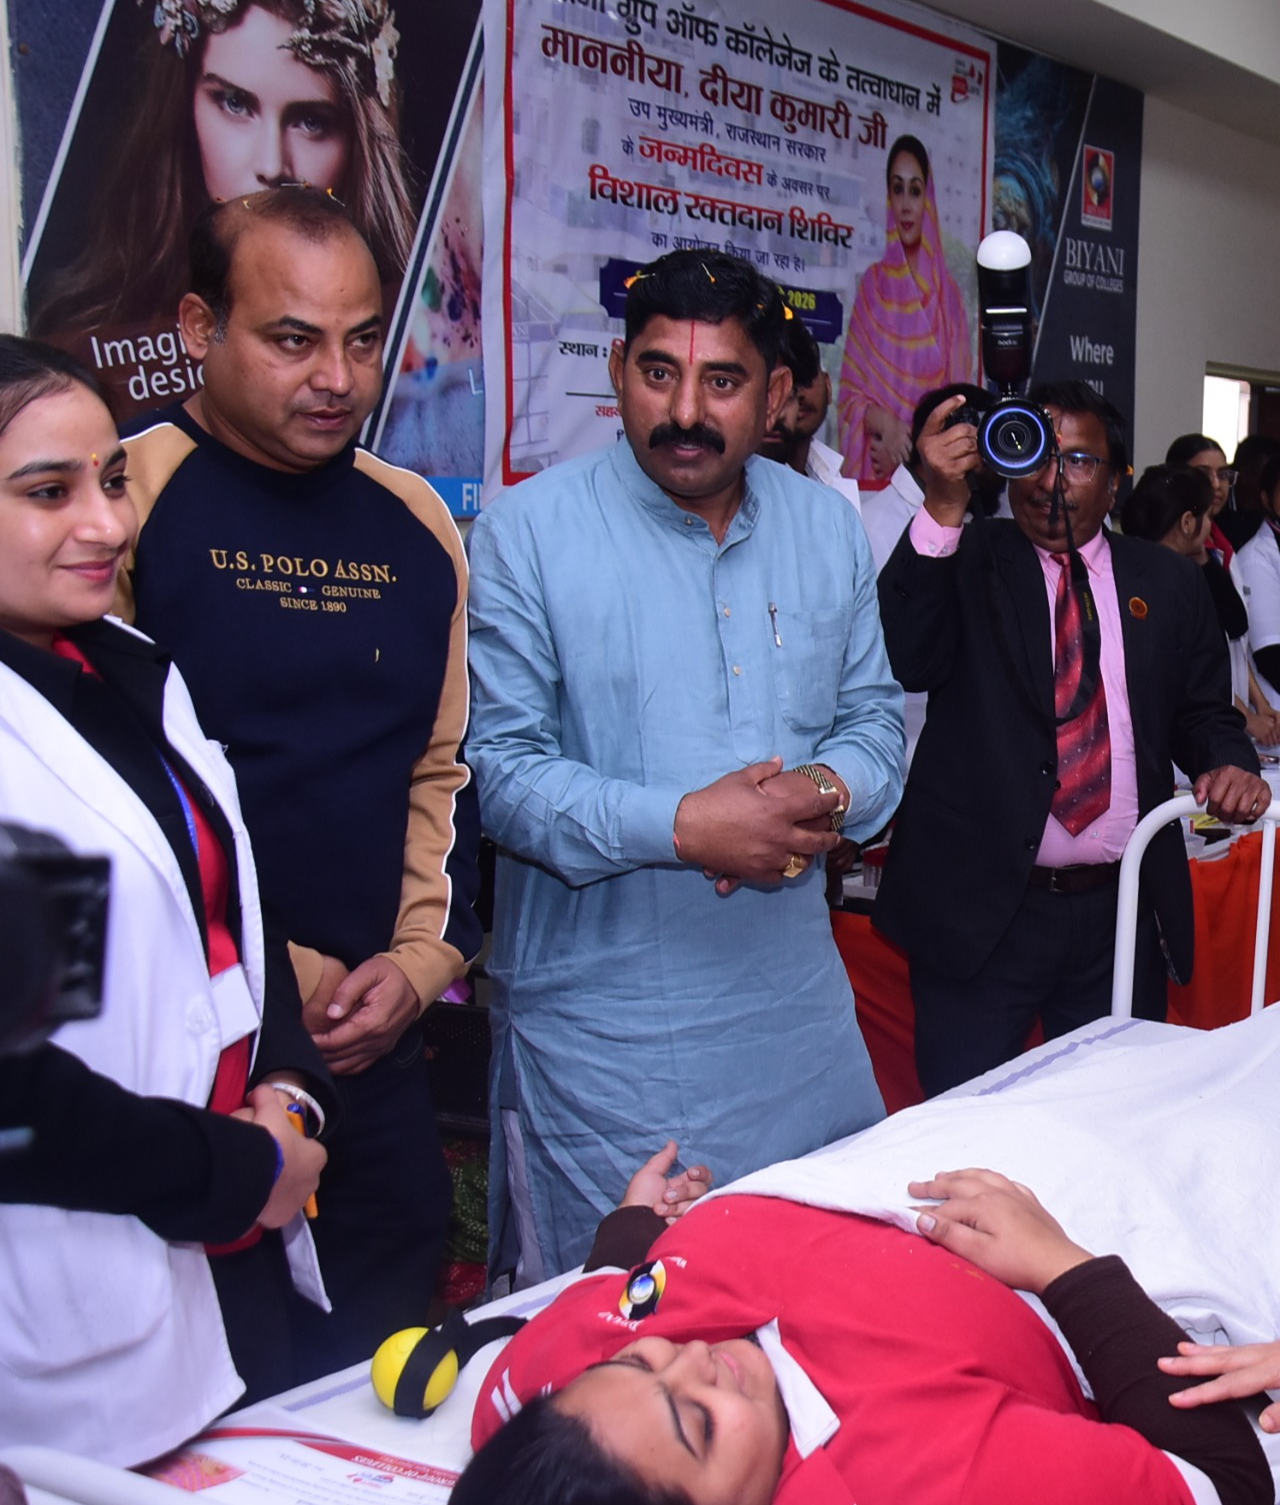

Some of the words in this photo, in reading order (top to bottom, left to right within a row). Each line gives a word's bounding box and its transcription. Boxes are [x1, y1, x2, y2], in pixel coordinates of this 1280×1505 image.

[666, 2, 719, 46] ऑफ
[725, 22, 812, 77] कॉलेजेज
[818, 47, 841, 83] के
[846, 65, 921, 111] तत्वाधान
[926, 83, 942, 116] में
[699, 63, 763, 116] दीया
[770, 89, 852, 139] कुमारी
[858, 111, 888, 149] जी
[628, 97, 650, 120] उप
[725, 122, 780, 152] राजस्थान
[785, 136, 826, 163] सरकार
[621, 136, 635, 156] के
[638, 136, 765, 186] जन्मदिवस
[766, 169, 778, 188] के
[781, 177, 814, 197] अवसर
[816, 184, 830, 200] पर
[588, 163, 682, 216] विशाल
[684, 192, 785, 236] रक्तदान
[789, 205, 855, 249] शिविर
[651, 232, 668, 249] का
[755, 250, 769, 265] जा
[1065, 237, 1124, 276] BIYANI
[788, 290, 816, 311] 2026
[91, 323, 187, 369] Imagi
[1070, 335, 1114, 366] Where
[210, 549, 256, 571] U.S.
[260, 554, 329, 578] POLO
[334, 559, 397, 583] ASSN.
[236, 578, 293, 593] CLASSIC
[321, 585, 382, 599] GENUINE
[280, 597, 319, 611] SINCE
[321, 600, 347, 613] 1890
